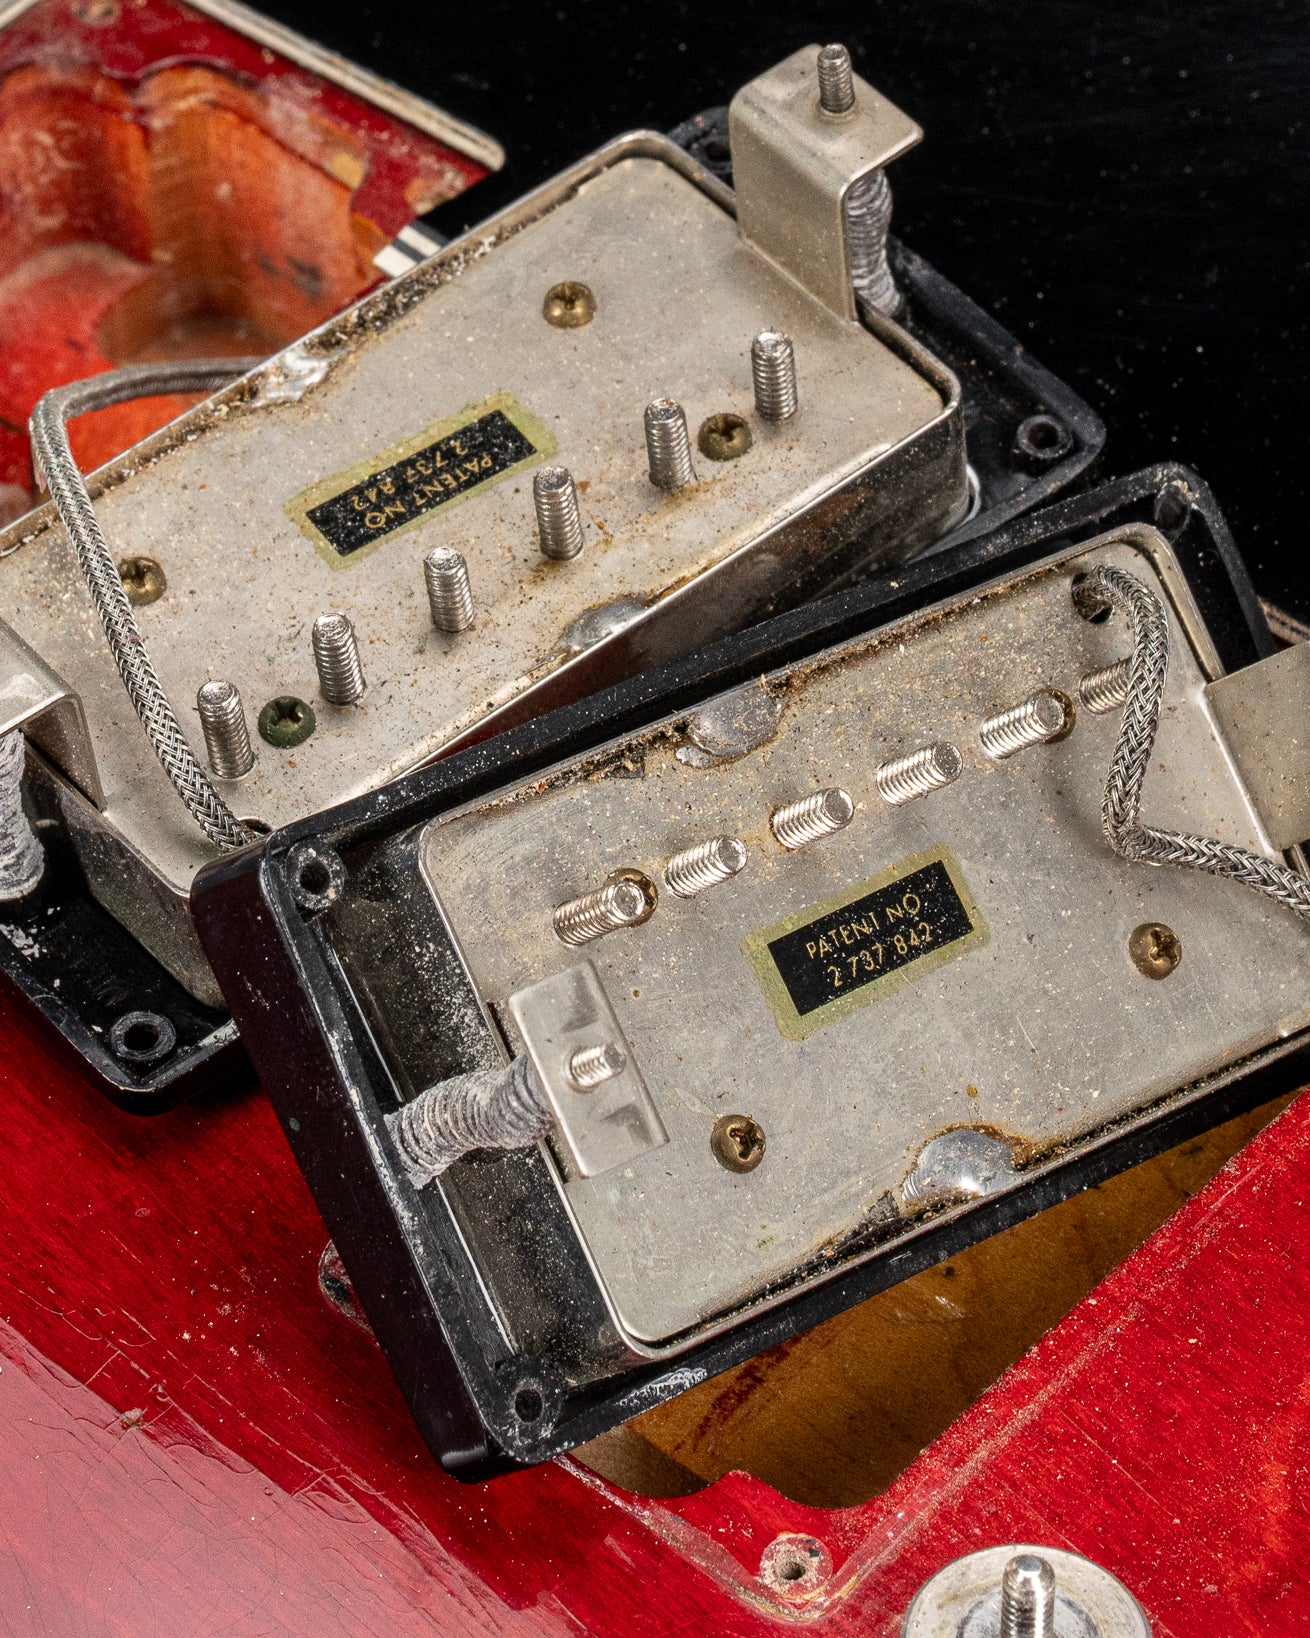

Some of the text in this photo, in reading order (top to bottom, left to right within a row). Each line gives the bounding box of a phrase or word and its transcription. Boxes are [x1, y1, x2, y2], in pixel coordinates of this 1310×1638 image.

[364, 453, 493, 529] PATENT NO
[805, 893, 921, 960] PATENT NO
